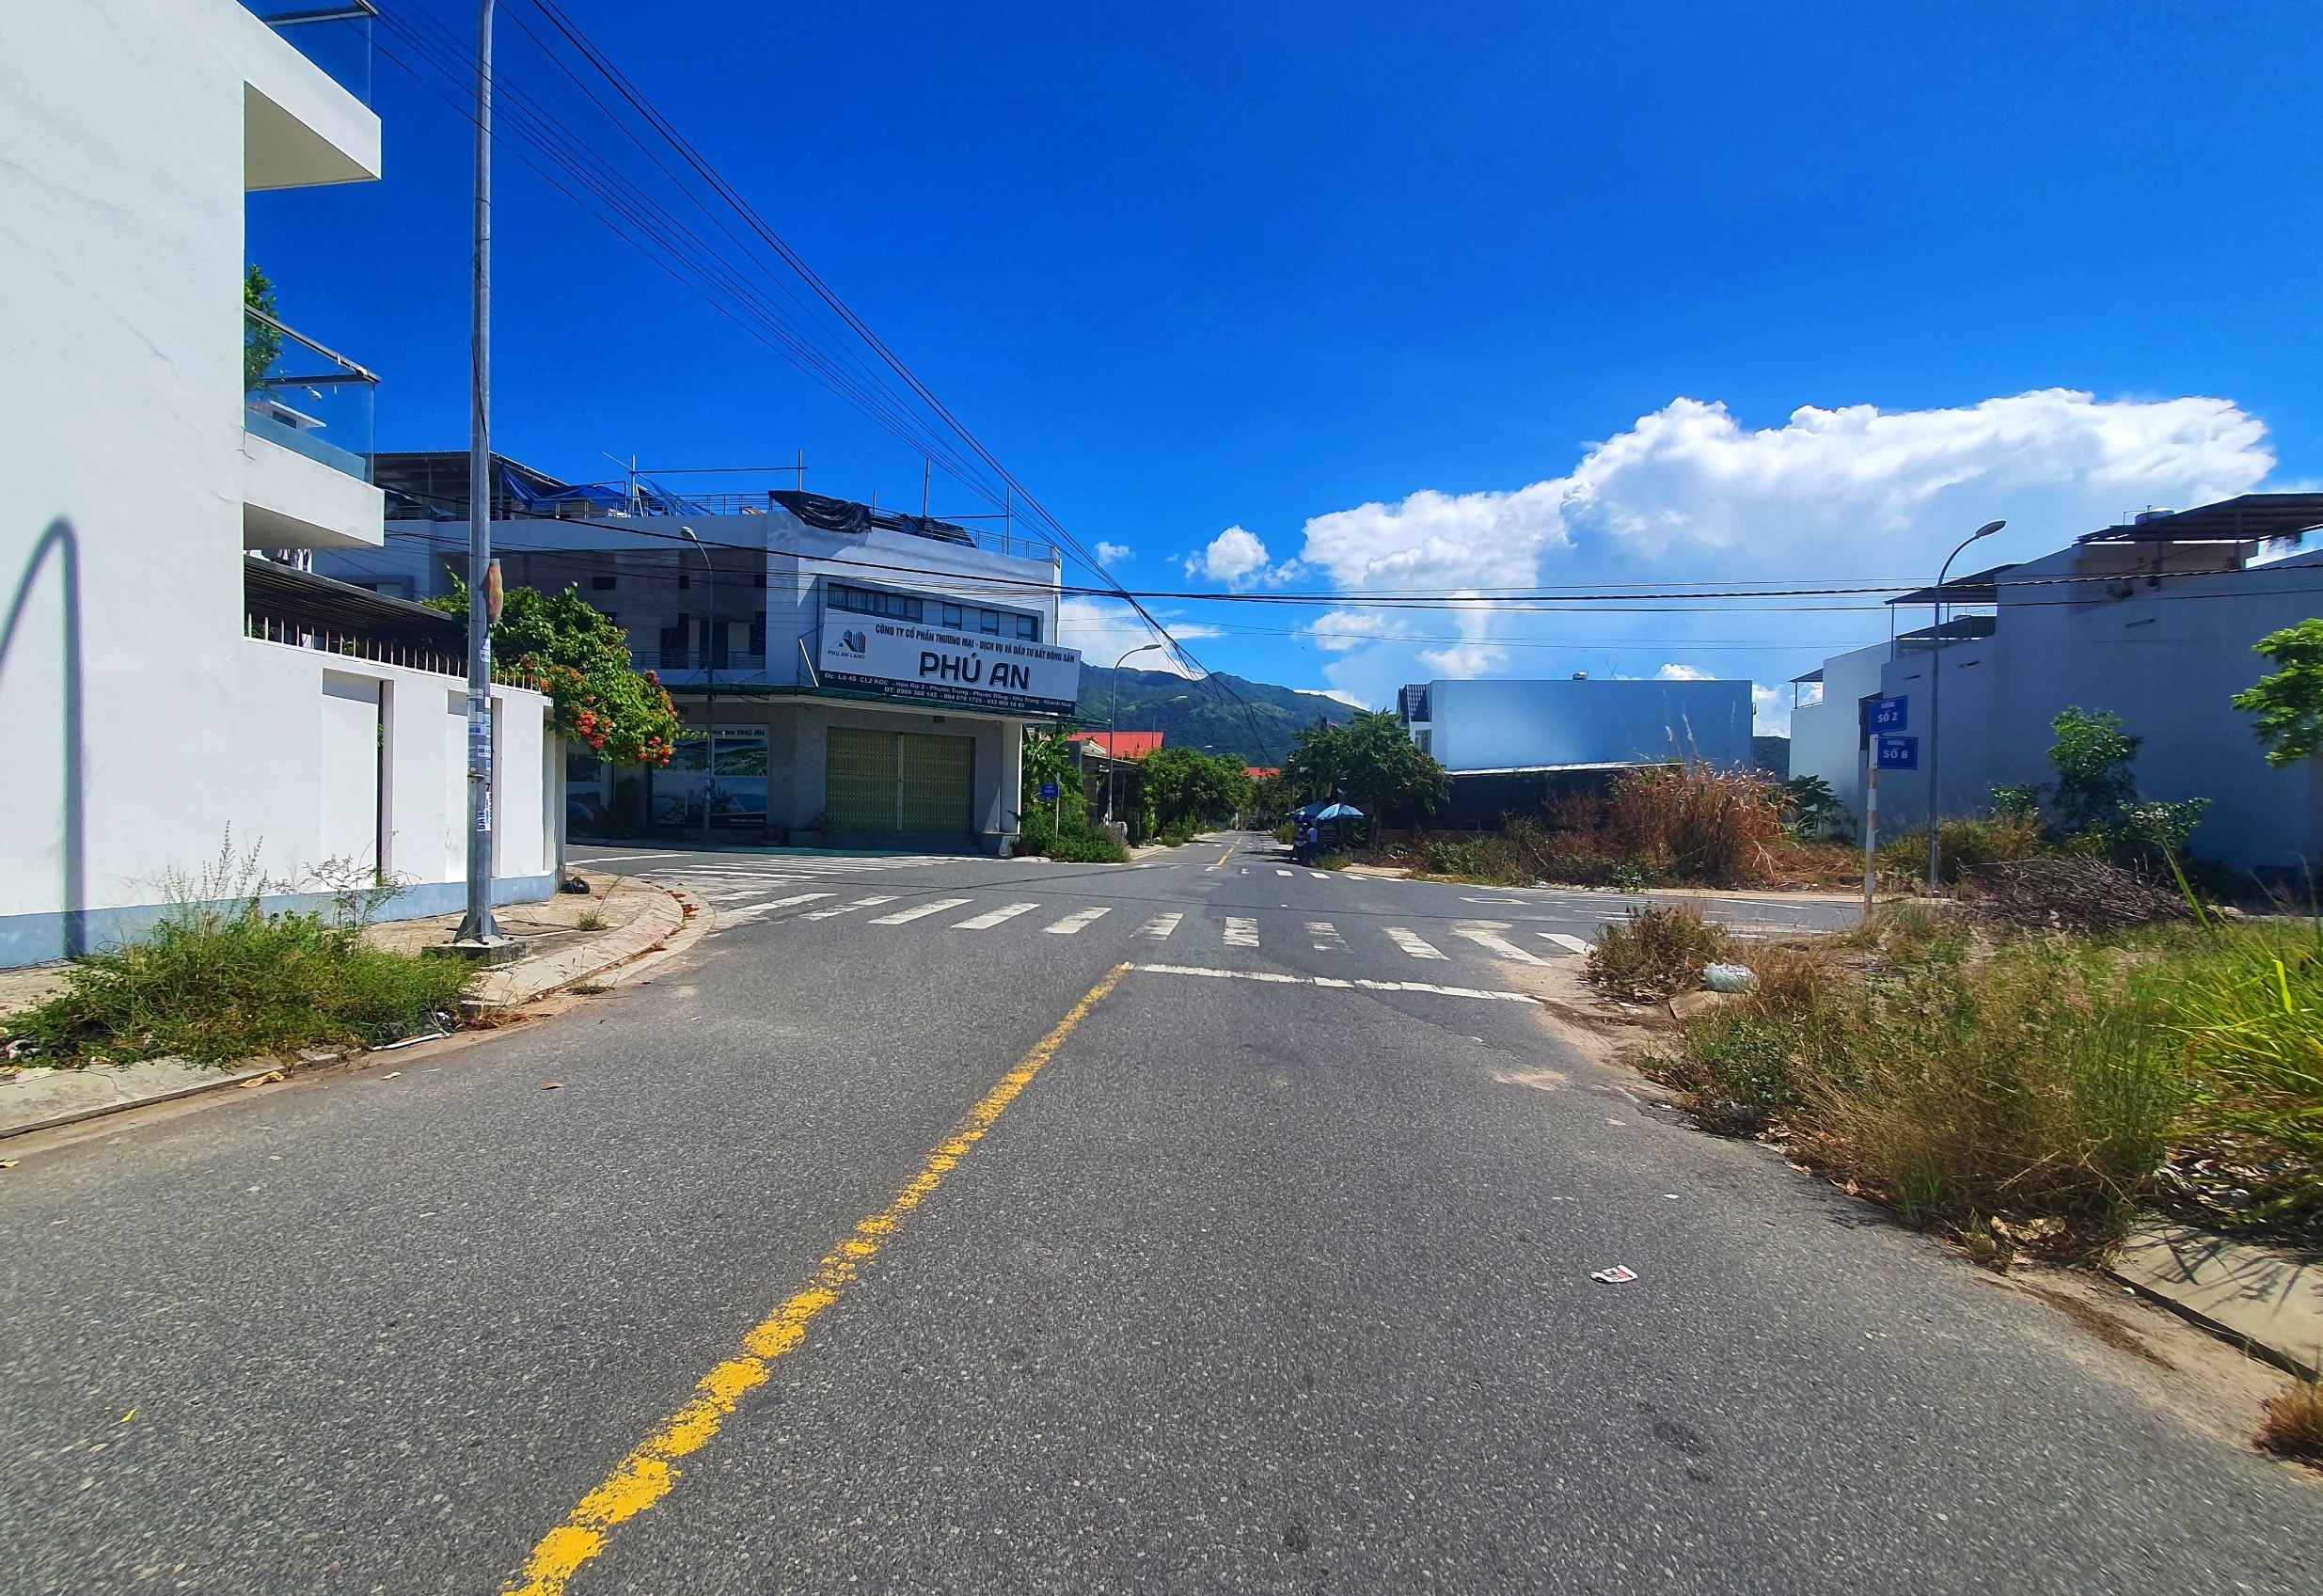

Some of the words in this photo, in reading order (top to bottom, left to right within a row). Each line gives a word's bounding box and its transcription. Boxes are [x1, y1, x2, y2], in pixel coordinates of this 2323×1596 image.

[876, 623, 894, 636] CÔNG
[896, 627, 904, 637] TY
[936, 633, 960, 645] THƯƠNG
[962, 638, 974, 650] MẠI
[980, 640, 994, 652] DỊCH
[995, 643, 1003, 655] VỤ
[1004, 644, 1012, 654] VÀ
[1026, 647, 1035, 656] TƯ
[919, 651, 982, 685] PHÚ
[988, 662, 1031, 691] AN
[952, 687, 969, 696] Trung
[1024, 697, 1039, 705] Trang
[1877, 710, 1890, 723] SỐ
[1892, 712, 1898, 720] 2
[1883, 747, 1900, 759] SỐ
[1901, 750, 1908, 759] 8
